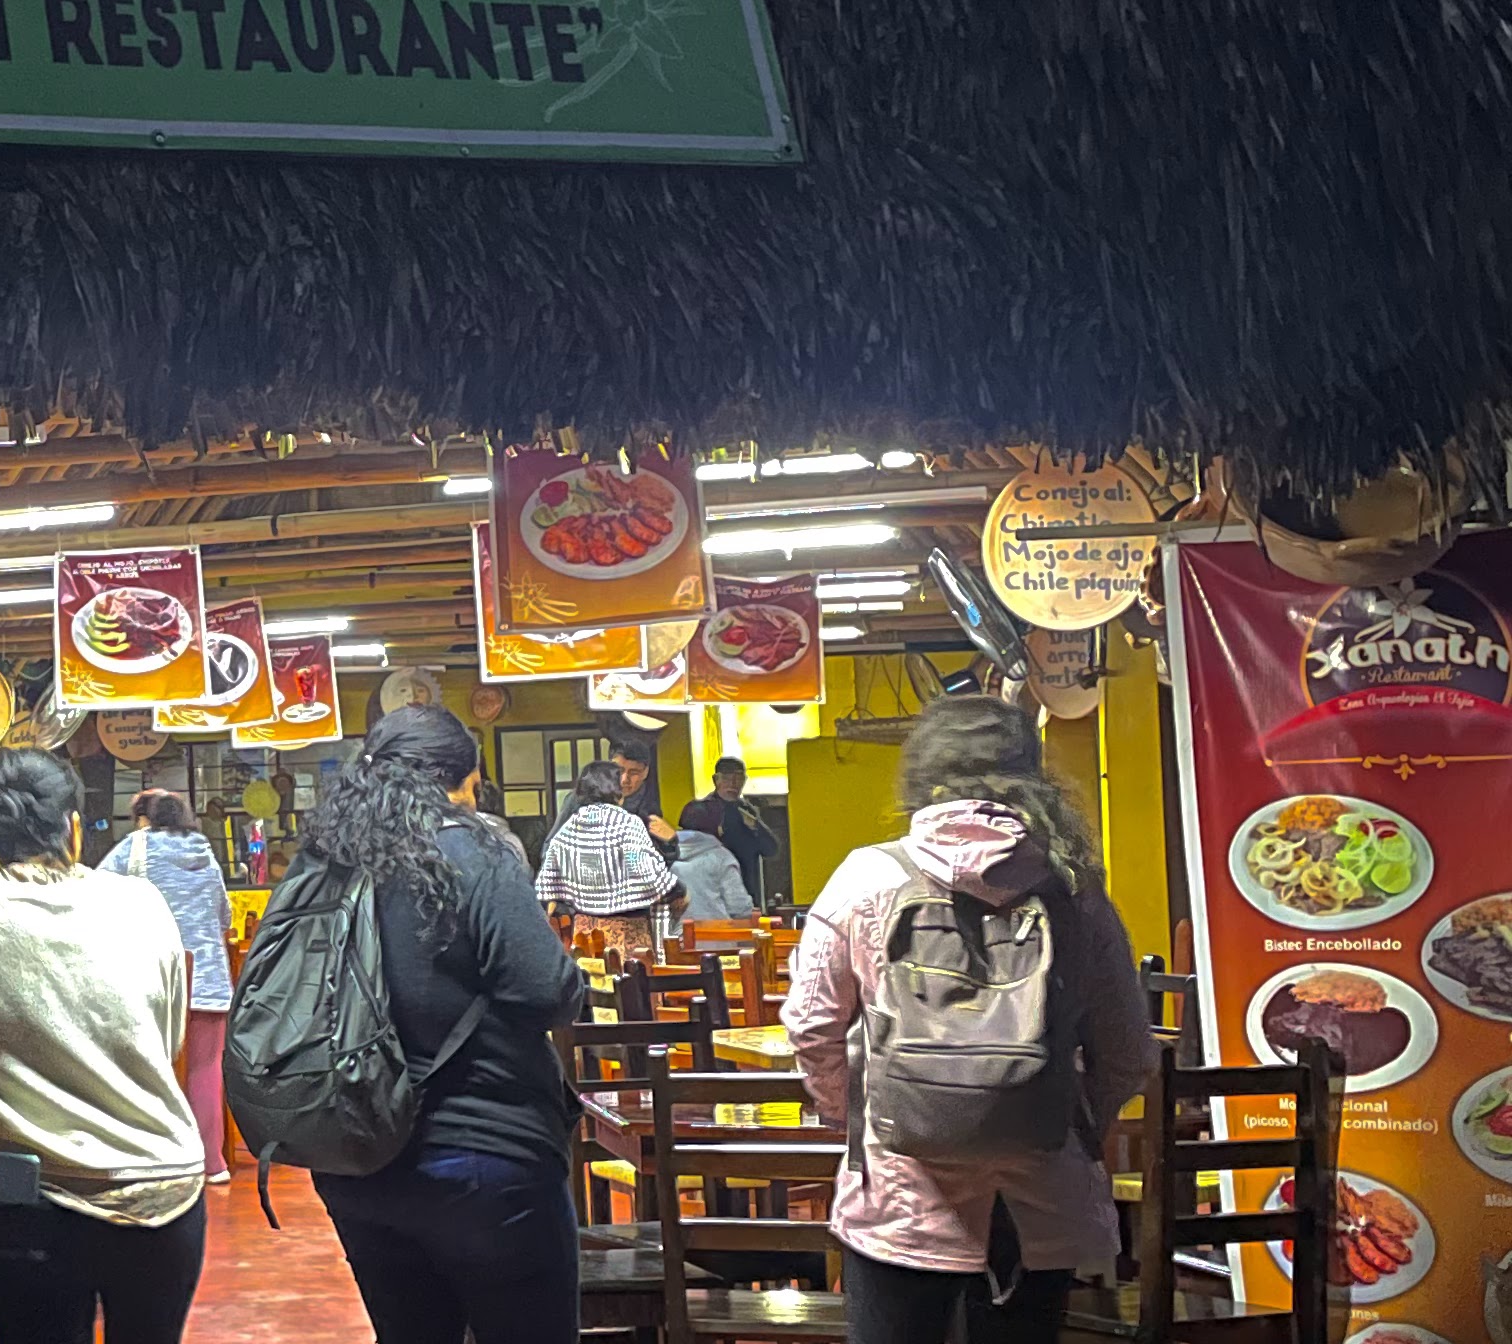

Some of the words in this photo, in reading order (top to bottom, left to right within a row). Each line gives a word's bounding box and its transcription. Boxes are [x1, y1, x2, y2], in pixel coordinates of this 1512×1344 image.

[1013, 480, 1100, 507] Conejo
[1003, 540, 1070, 570] Mojo
[1073, 542, 1102, 561] de
[1106, 542, 1144, 571] ajo
[1004, 571, 1070, 591] Chile
[1264, 939, 1303, 952] Bistec
[1306, 938, 1402, 951] Encebollado
[1279, 1098, 1297, 1110] Mo
[1343, 1118, 1439, 1134] combinado)
